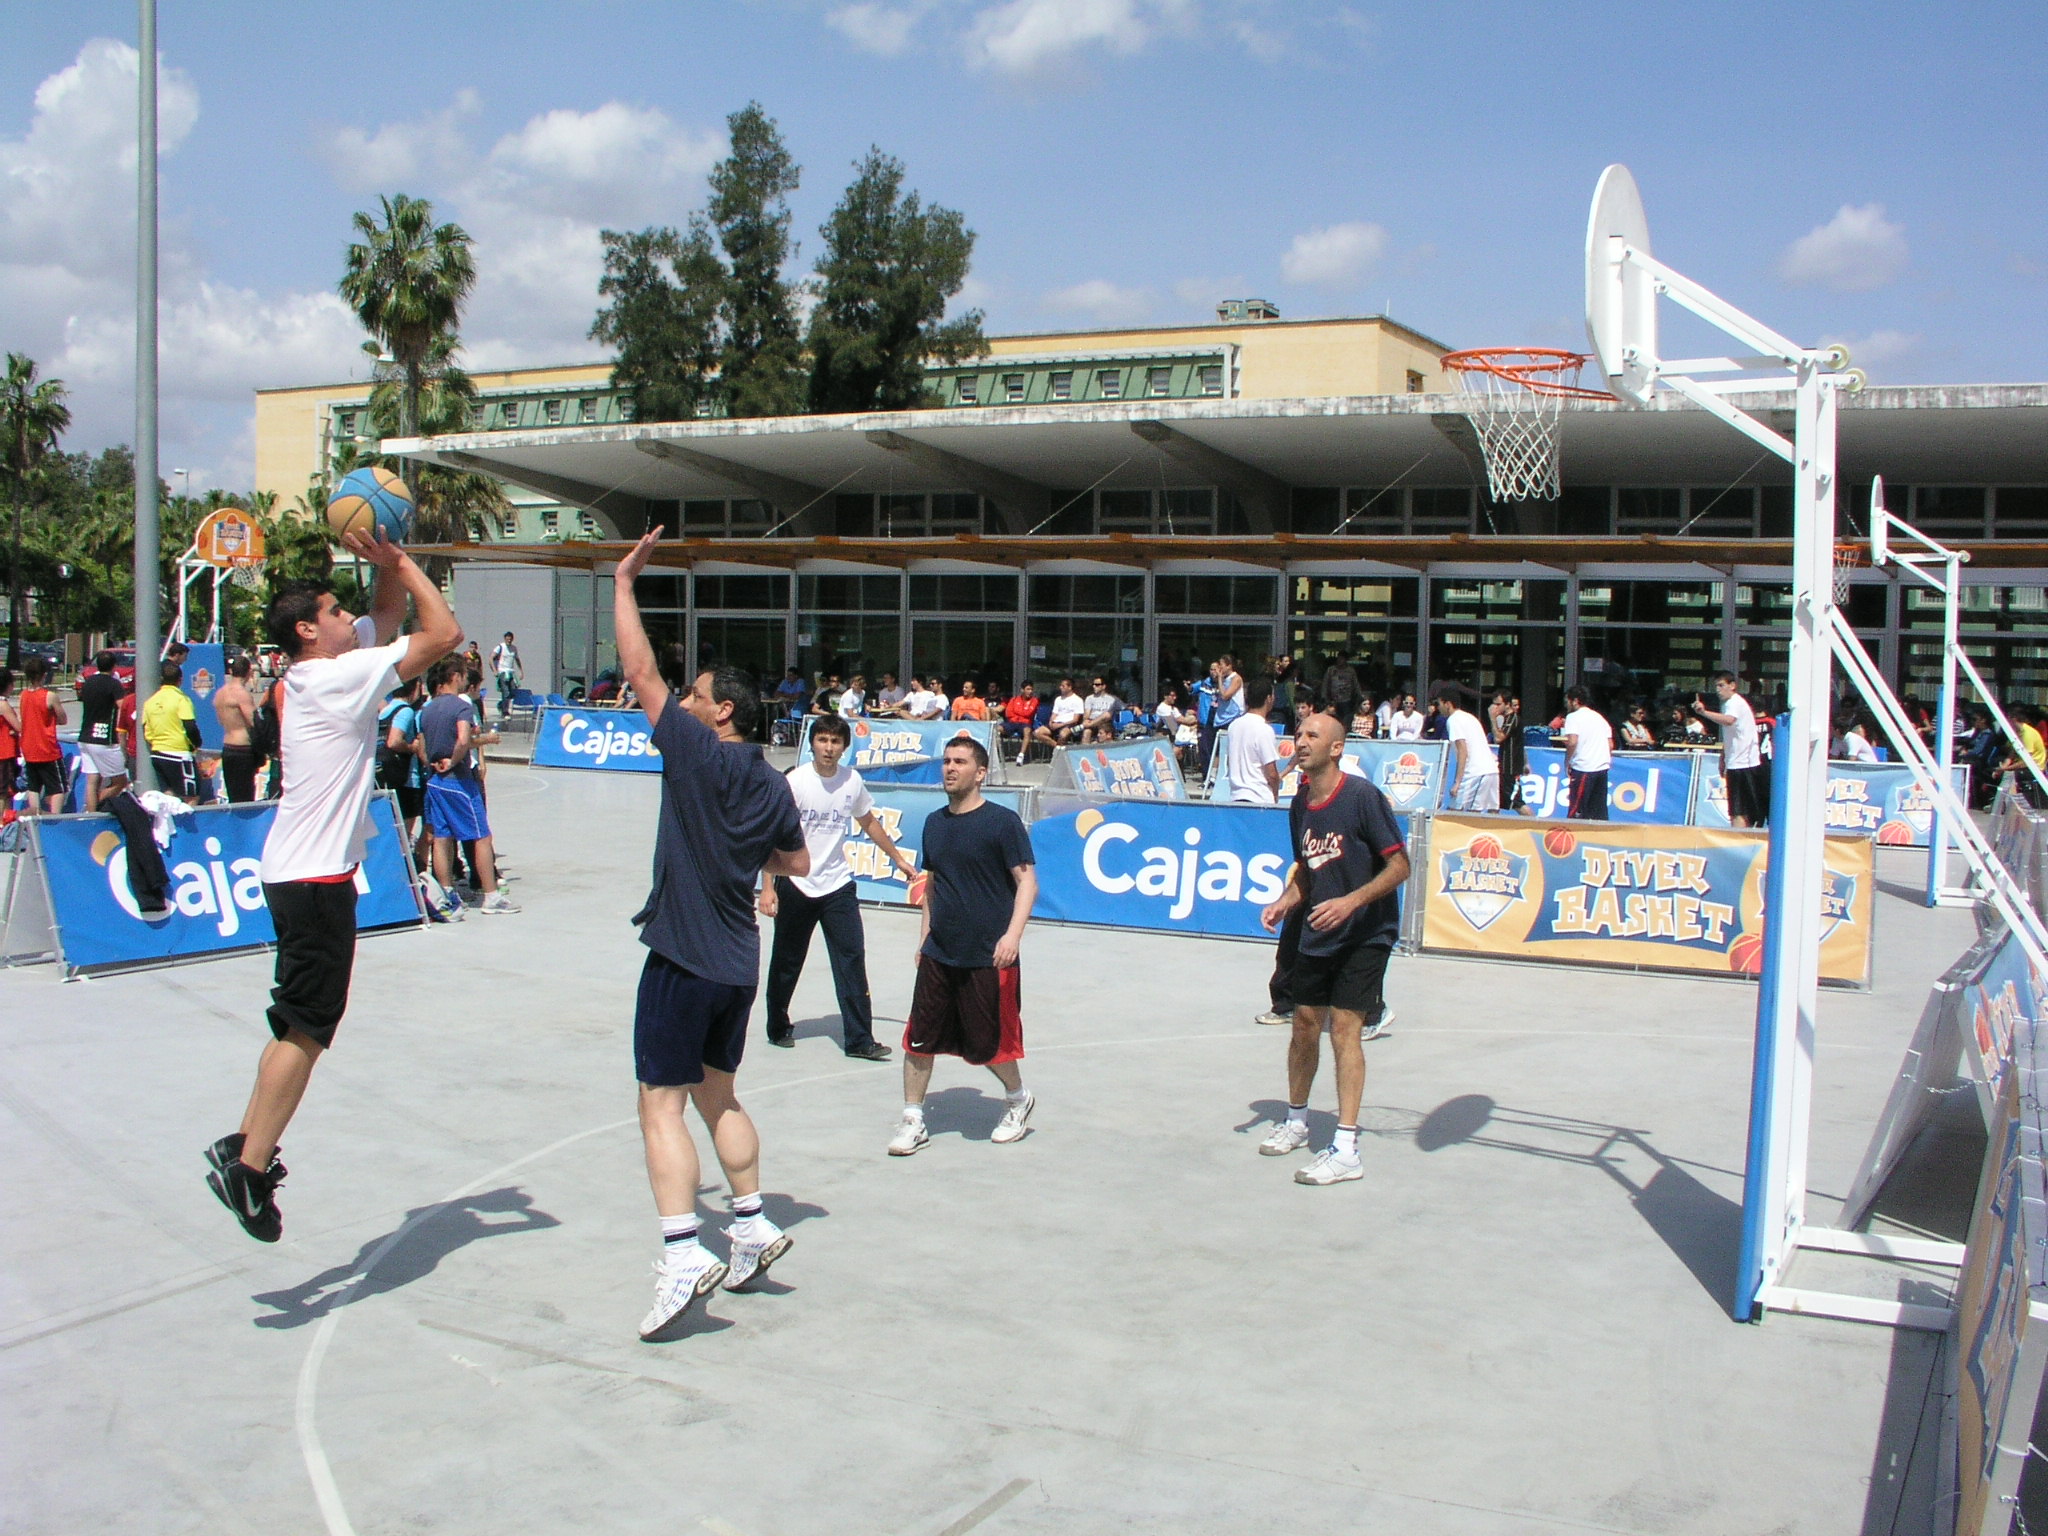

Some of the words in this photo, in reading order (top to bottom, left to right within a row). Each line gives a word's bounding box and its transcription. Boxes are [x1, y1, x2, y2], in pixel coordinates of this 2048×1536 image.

[868, 731, 923, 752] DIVER
[1825, 801, 1883, 829] KET
[1301, 828, 1341, 858] Levi's
[1083, 822, 1297, 920] Cajas
[1459, 856, 1511, 875] DIVER
[1579, 845, 1711, 896] DIVER
[1449, 870, 1519, 894] BASKET
[1551, 884, 1734, 945] BASKET
